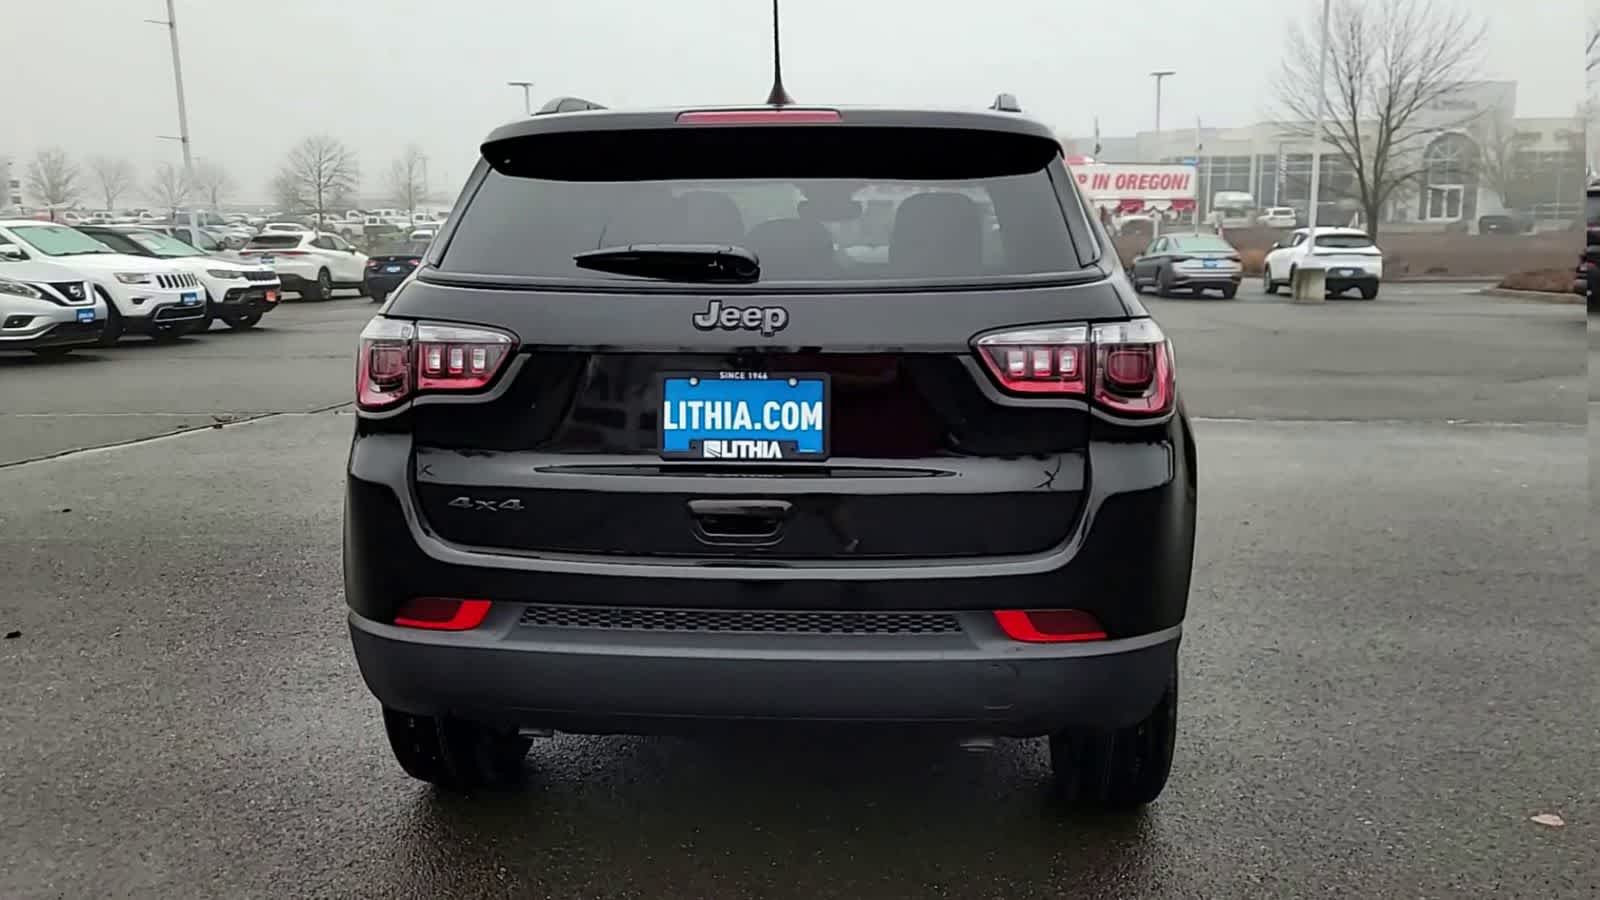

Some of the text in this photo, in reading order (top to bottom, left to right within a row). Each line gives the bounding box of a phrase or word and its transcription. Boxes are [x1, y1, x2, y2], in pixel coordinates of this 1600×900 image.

[1091, 173, 1111, 190] IN
[1115, 173, 1191, 190] OREGON!
[693, 300, 789, 337] Jeep
[719, 371, 745, 380] SINCE
[663, 400, 823, 431] LITHIA.COM
[722, 440, 783, 459] LITHIA
